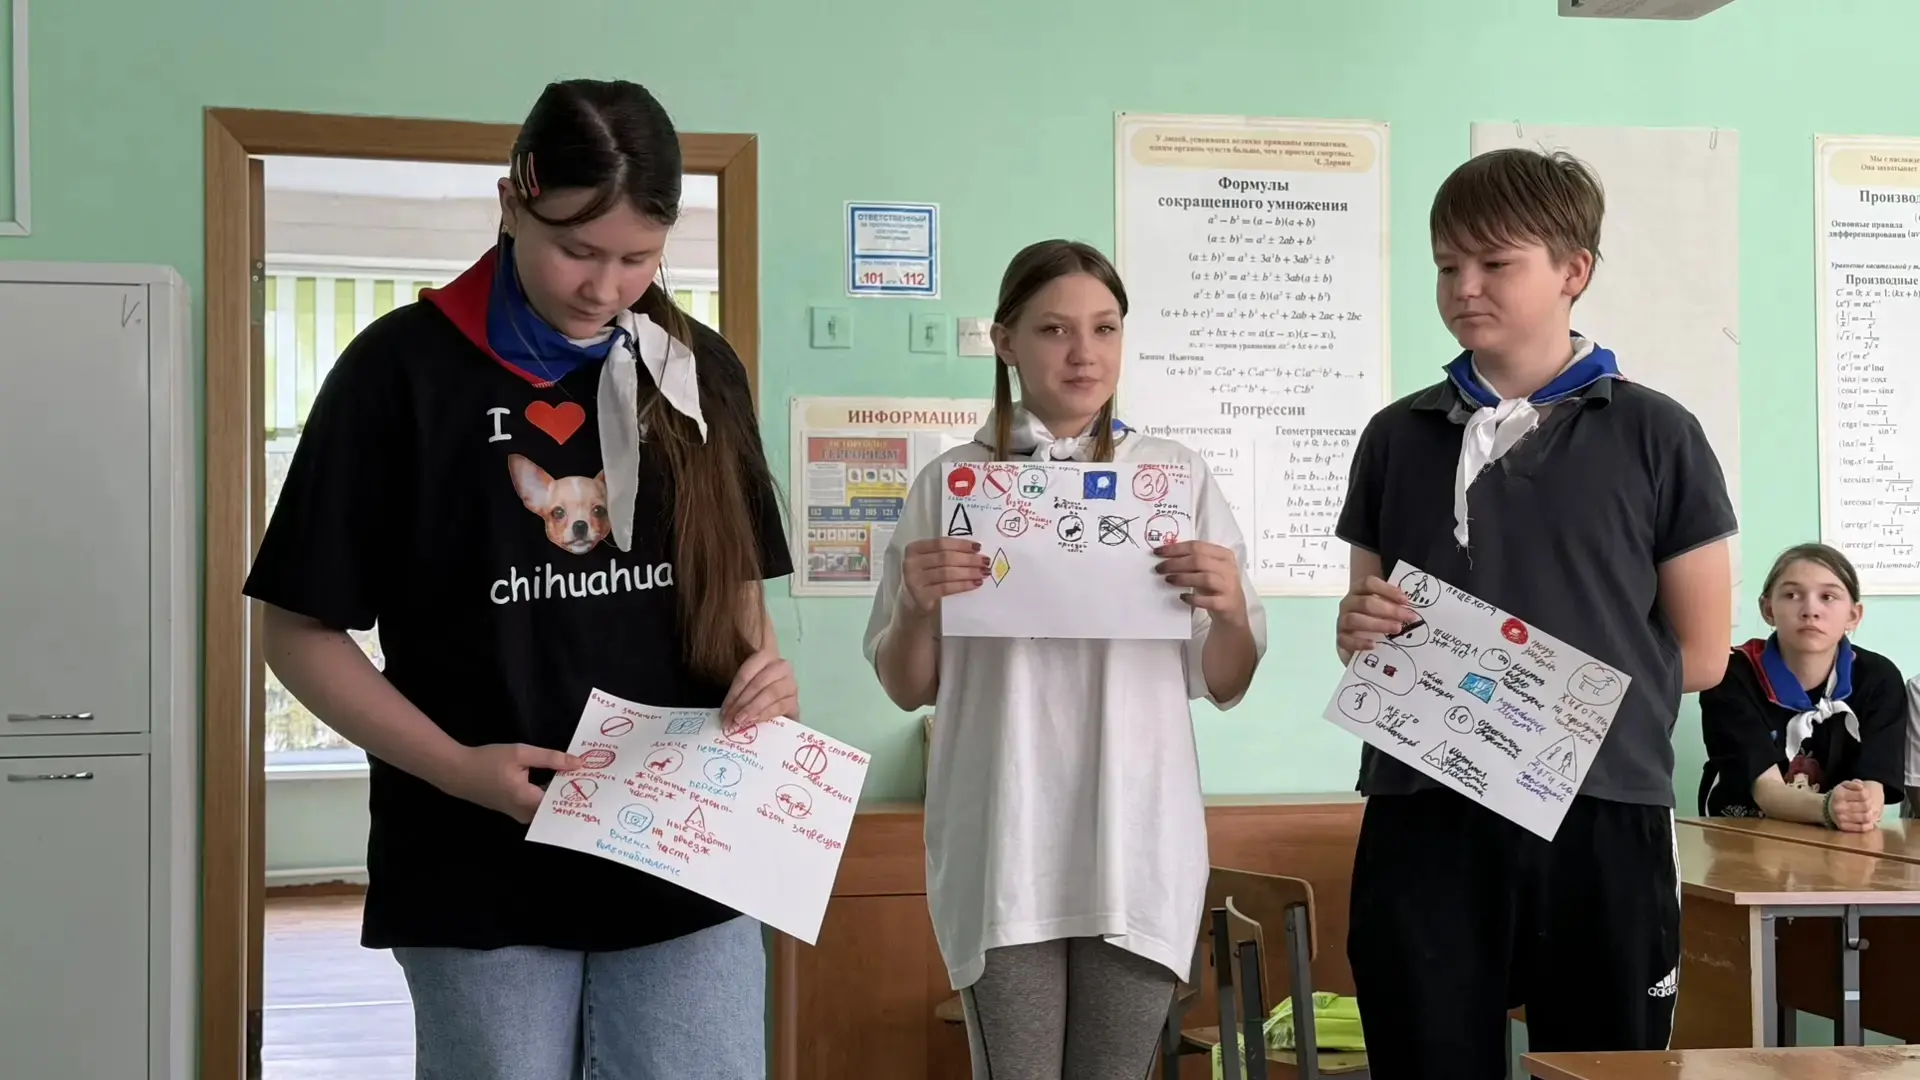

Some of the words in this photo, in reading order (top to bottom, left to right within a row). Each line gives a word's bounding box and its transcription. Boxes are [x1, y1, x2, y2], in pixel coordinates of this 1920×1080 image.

[1219, 177, 1289, 193] Формулы
[1159, 196, 1263, 210] сокращенного
[1267, 199, 1348, 213] умножения
[1831, 220, 1870, 228] Основные
[1872, 221, 1903, 229] правила
[864, 272, 883, 284] 101
[904, 273, 925, 285] 112
[1846, 274, 1918, 286] Производные
[848, 410, 977, 426] ИНФОРМАЦИЯ
[1220, 402, 1306, 418] Прогрессии
[486, 407, 512, 443] I
[1143, 425, 1232, 436] Арифметическая
[1276, 426, 1357, 437] Геометрическая
[1140, 473, 1166, 496] 30
[490, 558, 674, 604] chihuahua
